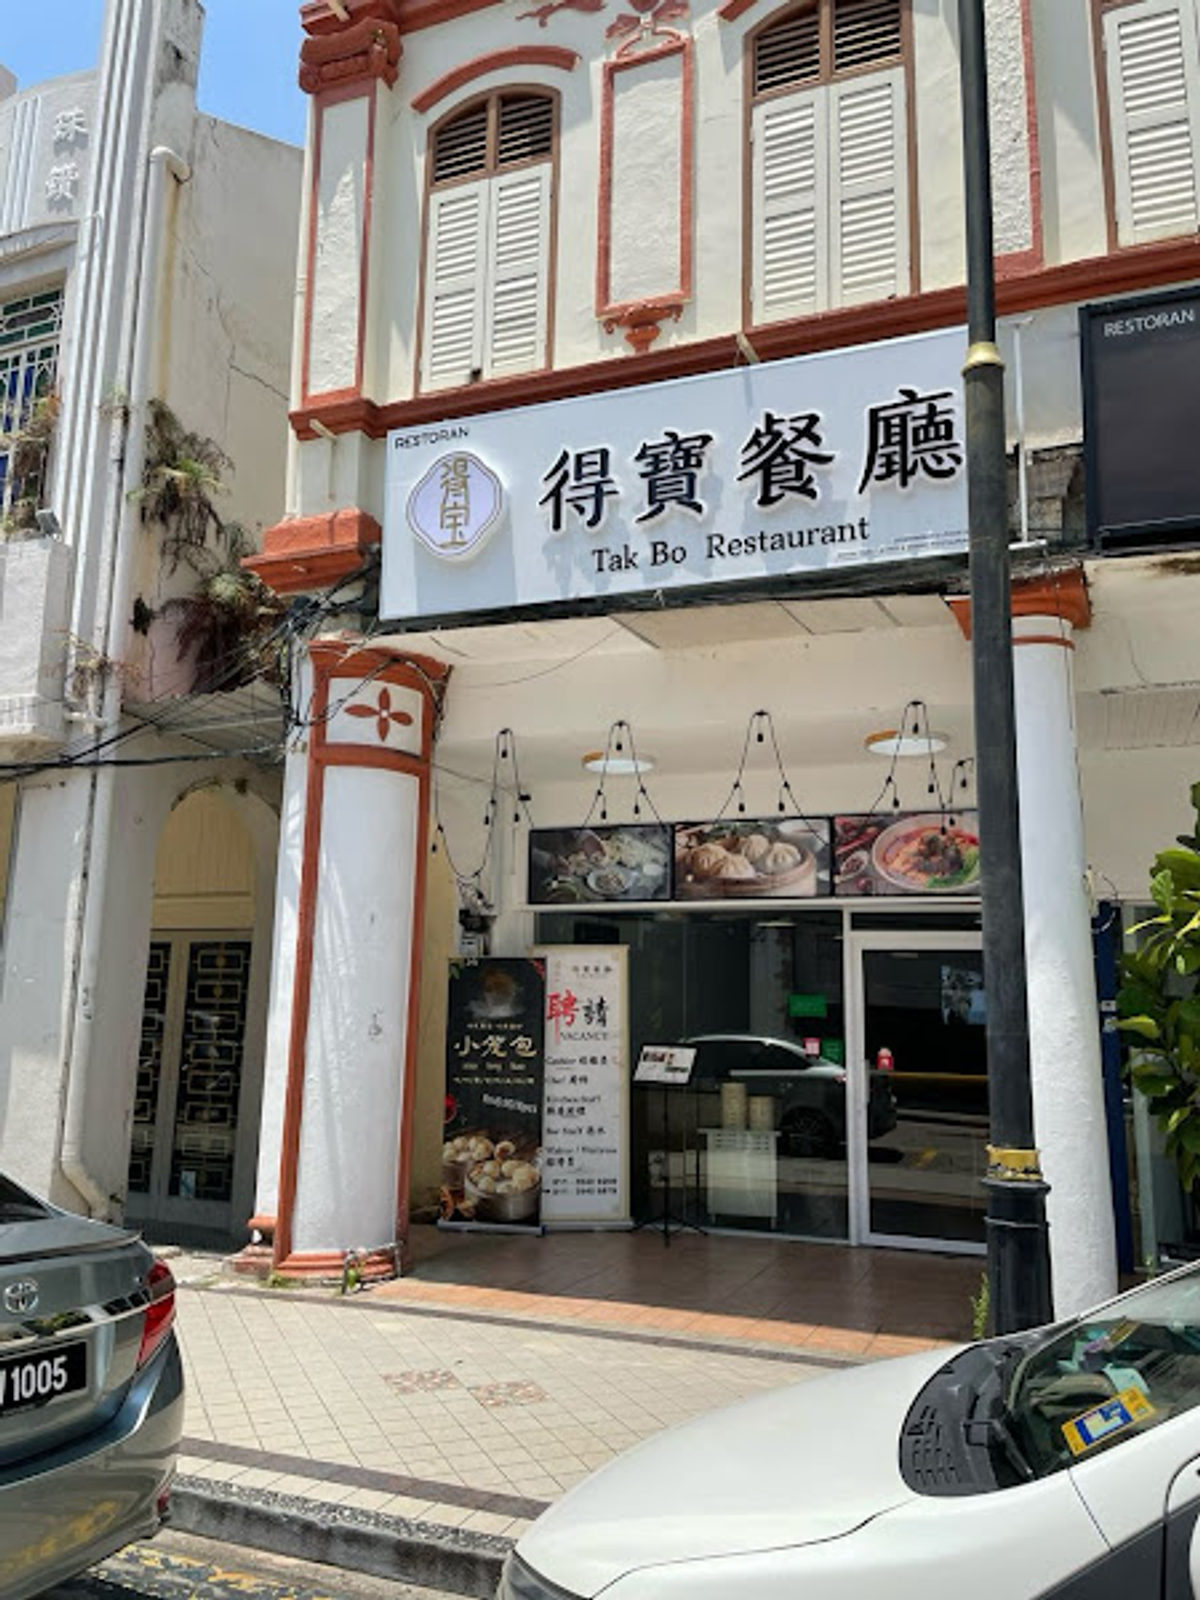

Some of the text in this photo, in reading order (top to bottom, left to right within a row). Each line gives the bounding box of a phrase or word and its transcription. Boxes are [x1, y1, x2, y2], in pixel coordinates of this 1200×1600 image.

[1103, 308, 1195, 338] RESTORAN
[395, 426, 470, 449] RESTORAN
[538, 389, 963, 533] 得寶餐廳
[592, 547, 639, 573] Tak
[651, 541, 687, 568] Bo
[706, 516, 870, 560] Restaurant
[11, 1355, 68, 1402] 1005
